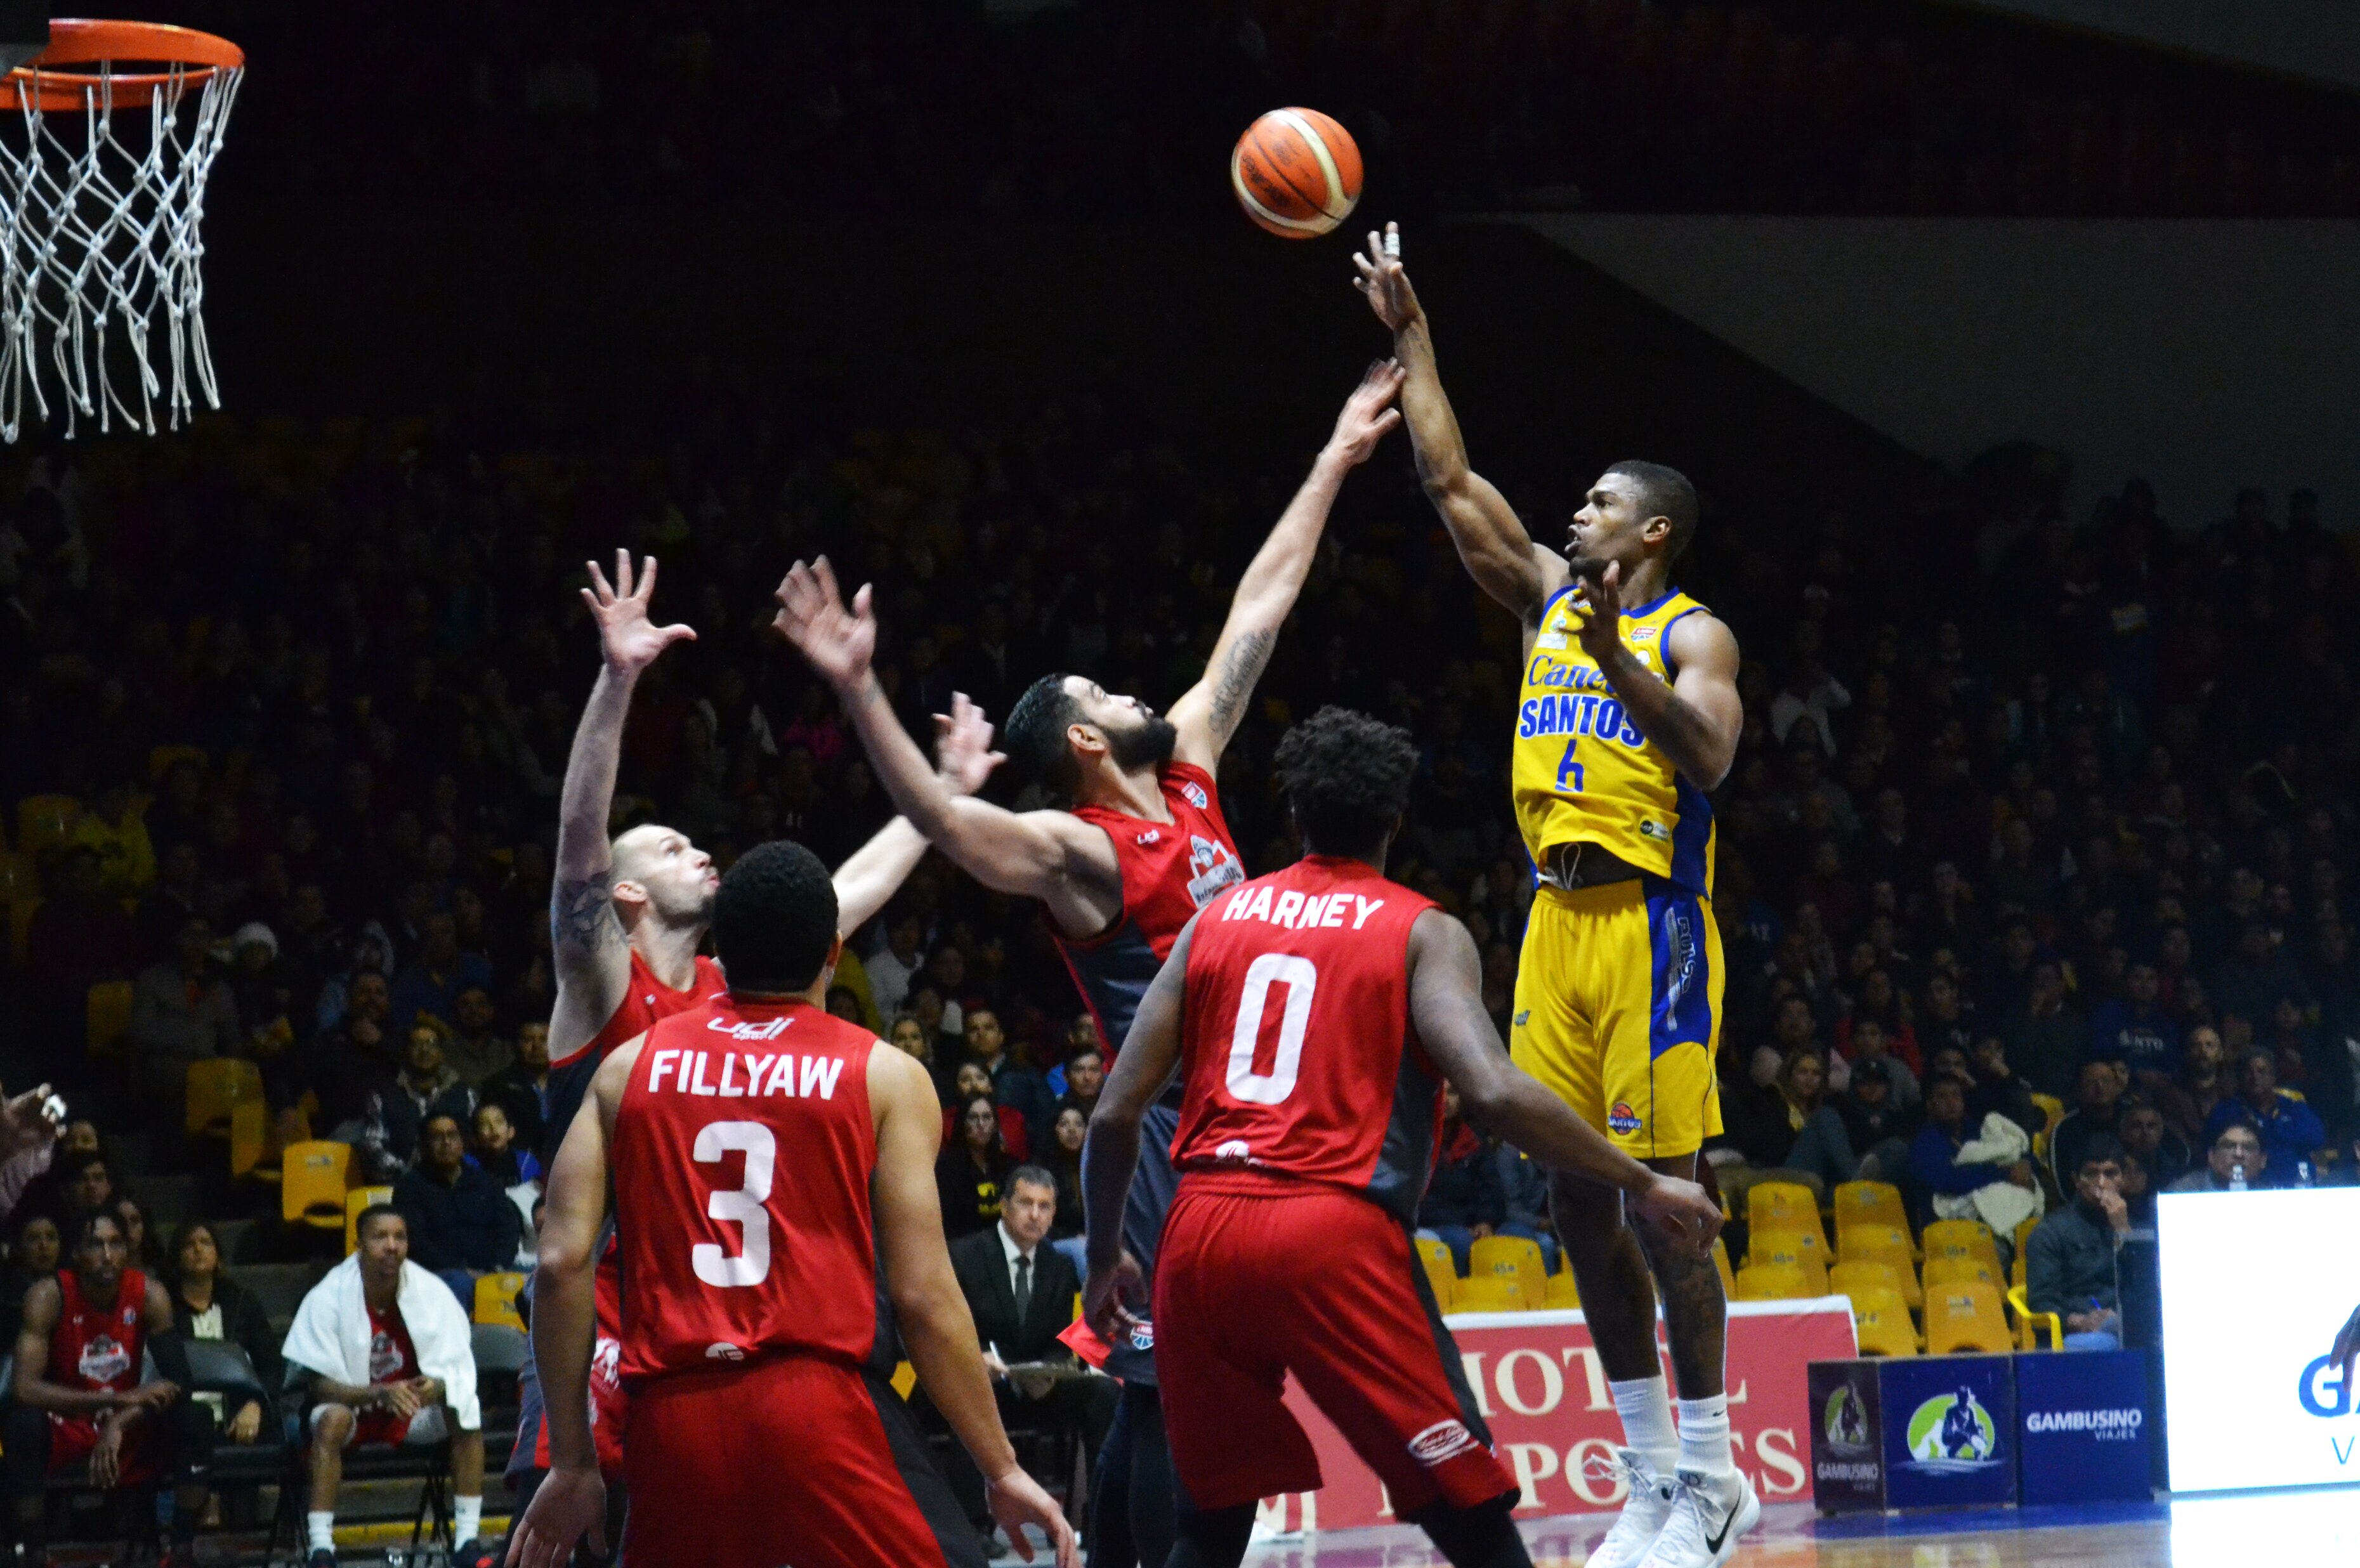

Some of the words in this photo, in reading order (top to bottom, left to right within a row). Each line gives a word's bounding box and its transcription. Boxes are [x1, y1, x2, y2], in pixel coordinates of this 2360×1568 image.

[1528, 655, 1616, 694] Cane
[1519, 693, 1646, 748] SANTOS
[1222, 886, 1384, 930] HARNEY
[1225, 953, 1317, 1105] 0
[648, 1050, 844, 1100] FILLYAW
[692, 1121, 776, 1287] 3
[2298, 1353, 2360, 1418] G
[2026, 1408, 2142, 1434] GAMBUSINO
